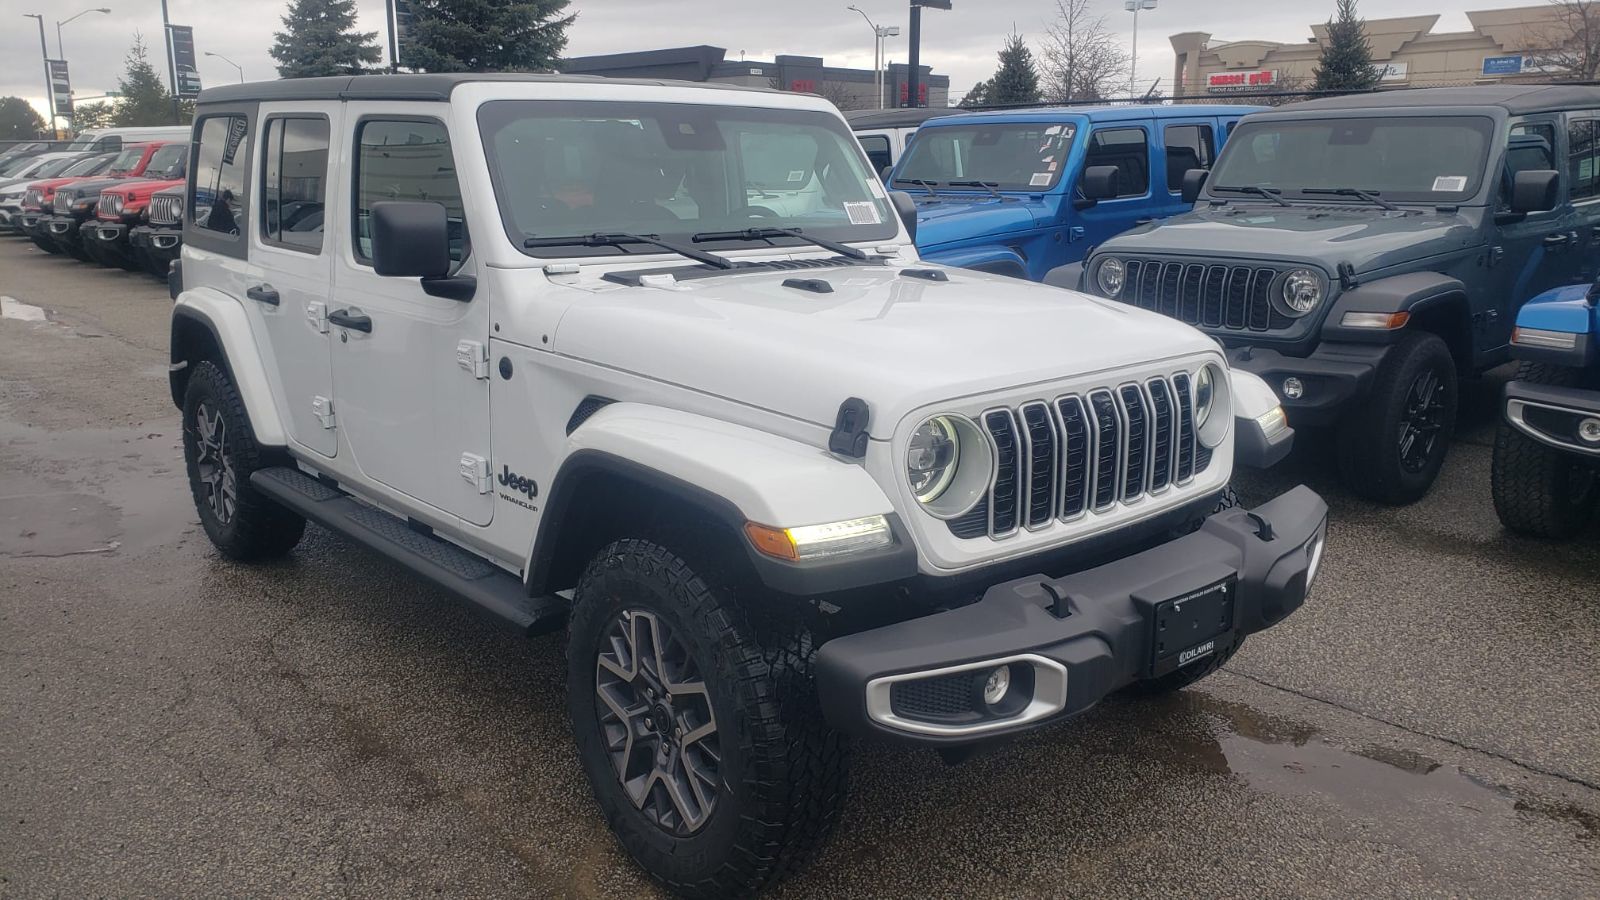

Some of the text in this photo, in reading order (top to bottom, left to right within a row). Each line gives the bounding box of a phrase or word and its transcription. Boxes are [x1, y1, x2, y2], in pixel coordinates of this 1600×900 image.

[498, 464, 538, 500] Jeep
[499, 492, 538, 512] WRANGLER
[1186, 640, 1214, 660] DILAWRI
